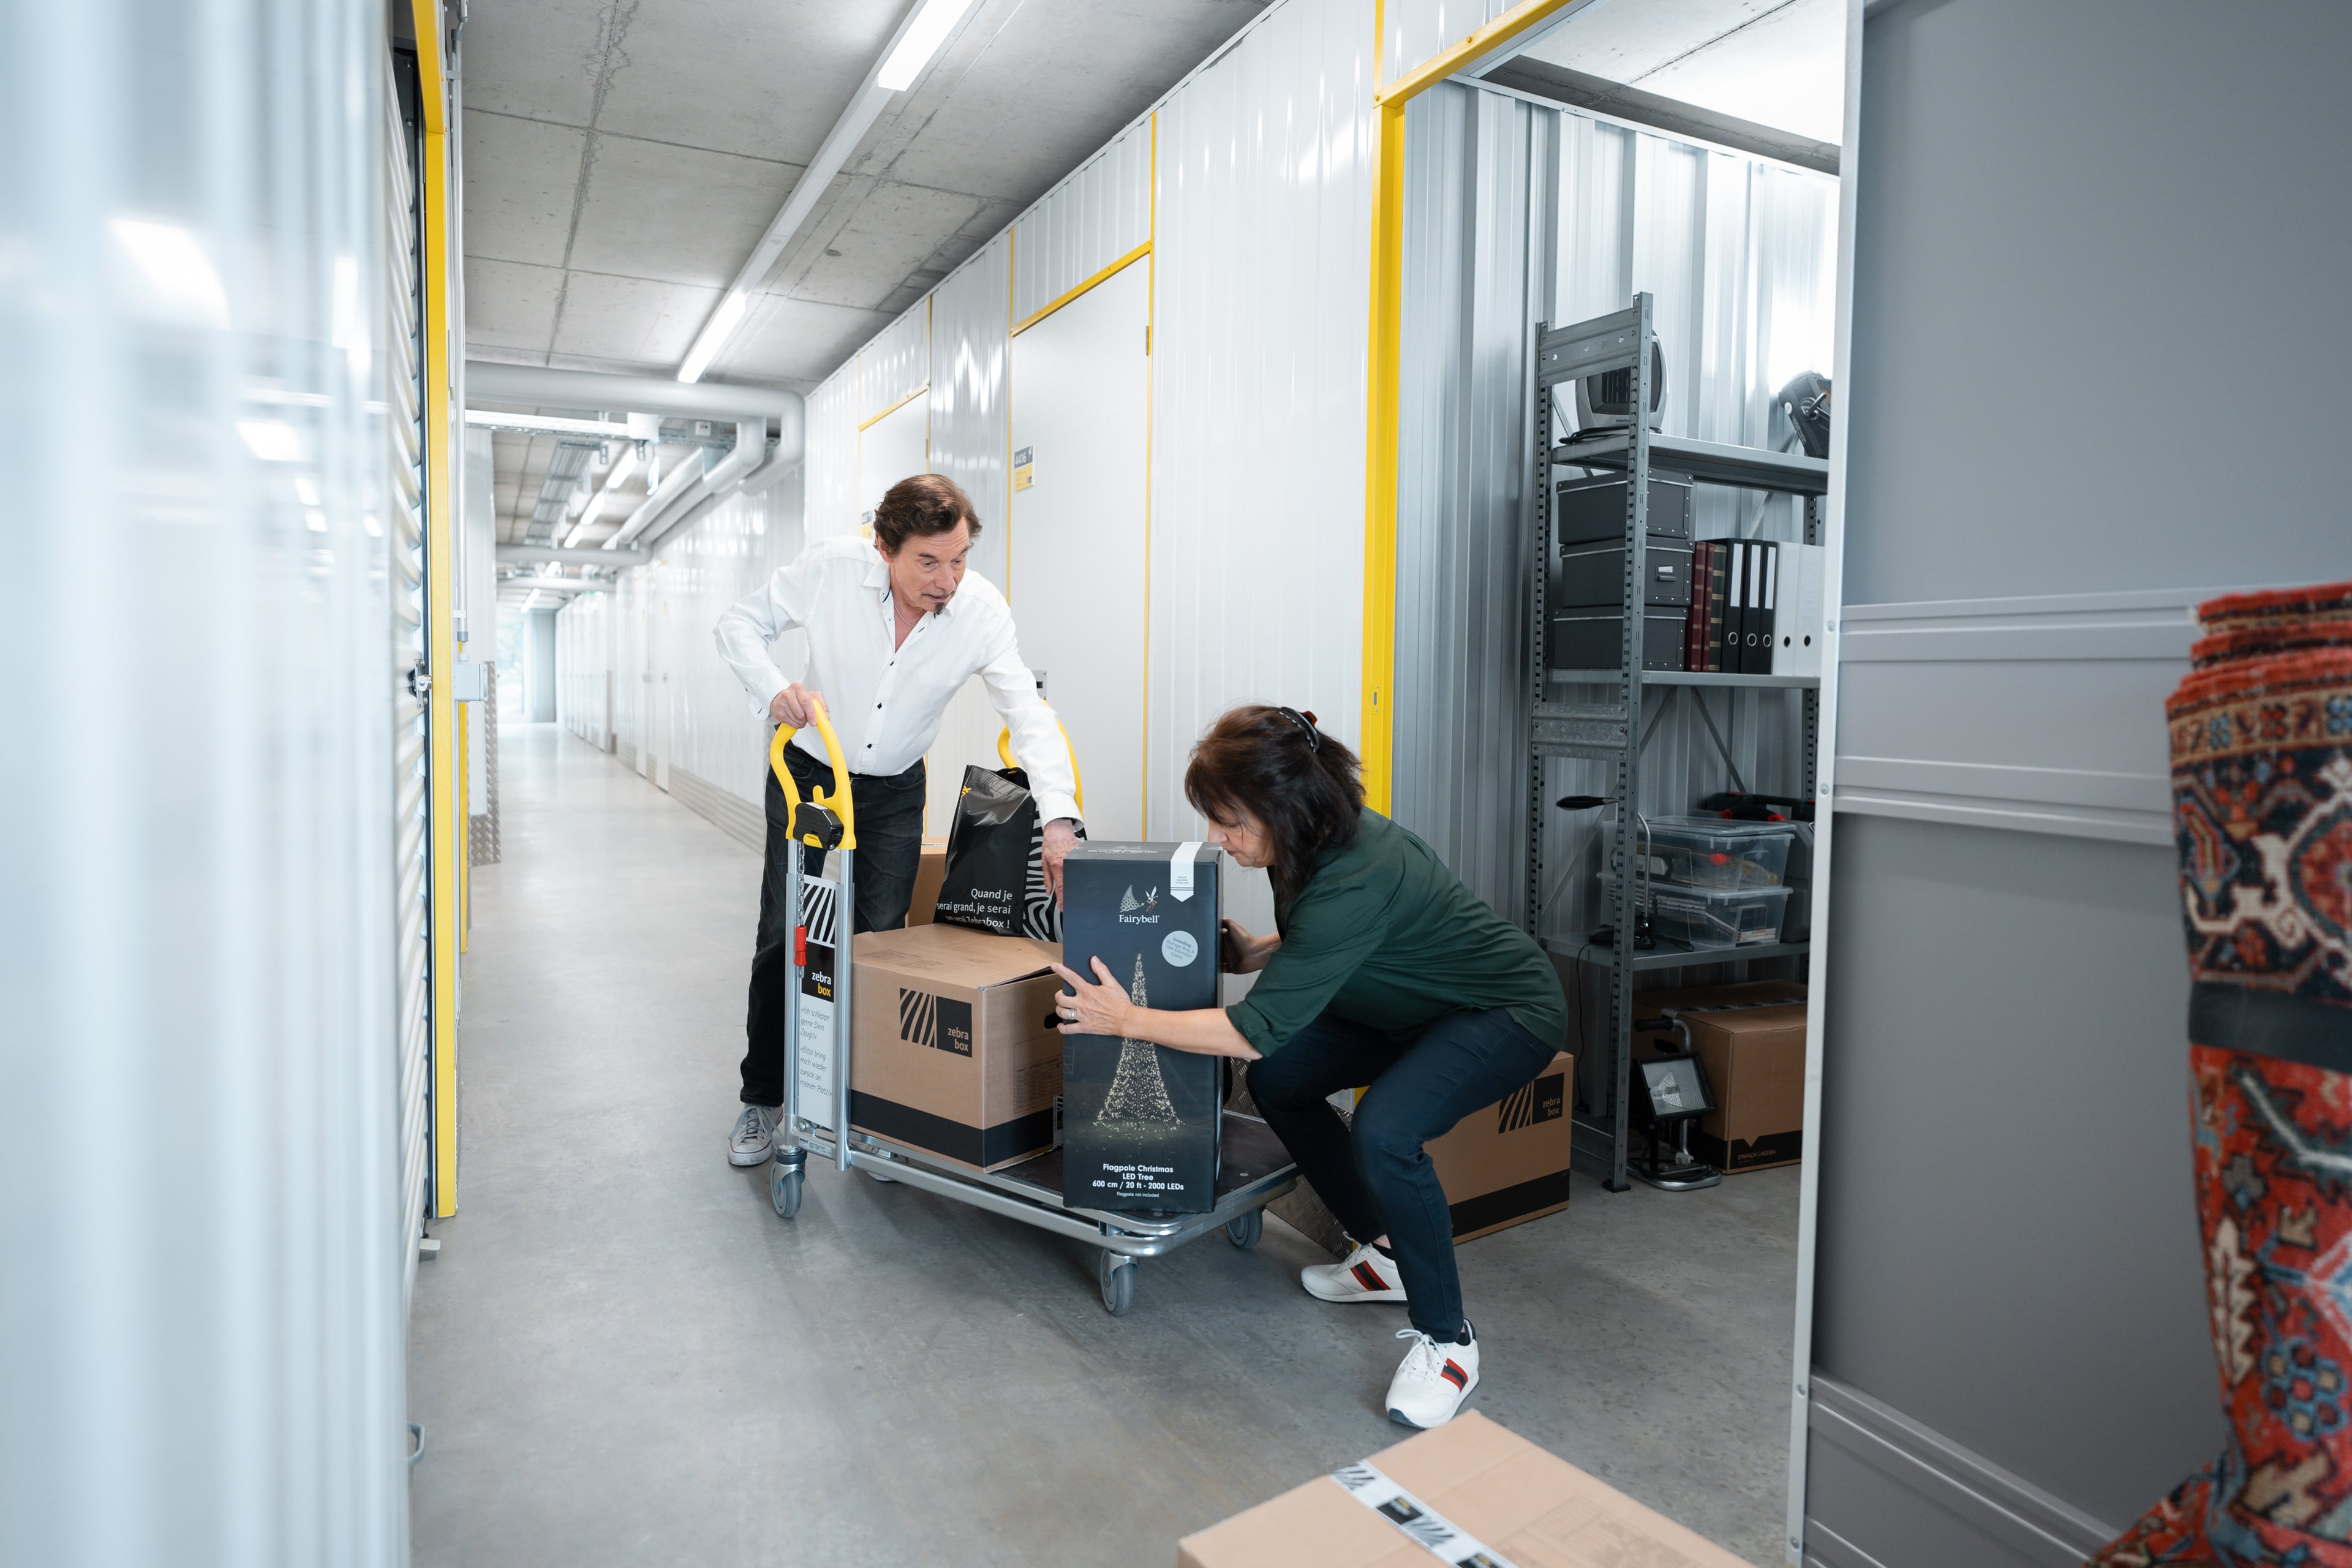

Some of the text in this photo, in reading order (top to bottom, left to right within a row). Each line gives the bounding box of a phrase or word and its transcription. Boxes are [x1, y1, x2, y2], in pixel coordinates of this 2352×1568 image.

[971, 888, 1012, 902] Quand je
[937, 902, 1011, 914] serai grand, je serai
[966, 916, 1004, 928] Zebrabox
[1006, 919, 1010, 929] !
[1118, 914, 1158, 925] Fairybell
[1173, 937, 1191, 948] Including
[812, 971, 831, 985] zebra
[818, 983, 831, 997] box
[811, 1009, 830, 1022] schleppe
[801, 1019, 824, 1031] gerne Dein
[948, 1027, 969, 1040] zebra
[954, 1038, 969, 1052] box
[814, 1050, 826, 1061] bring
[812, 1062, 827, 1071] wieder
[800, 1069, 815, 1079] zurück
[800, 1080, 816, 1090] meinen
[1542, 1097, 1560, 1108] zebra
[1548, 1107, 1559, 1116] box
[1738, 1152, 1757, 1160] EINFACH
[1103, 1163, 1136, 1172] Flagpole
